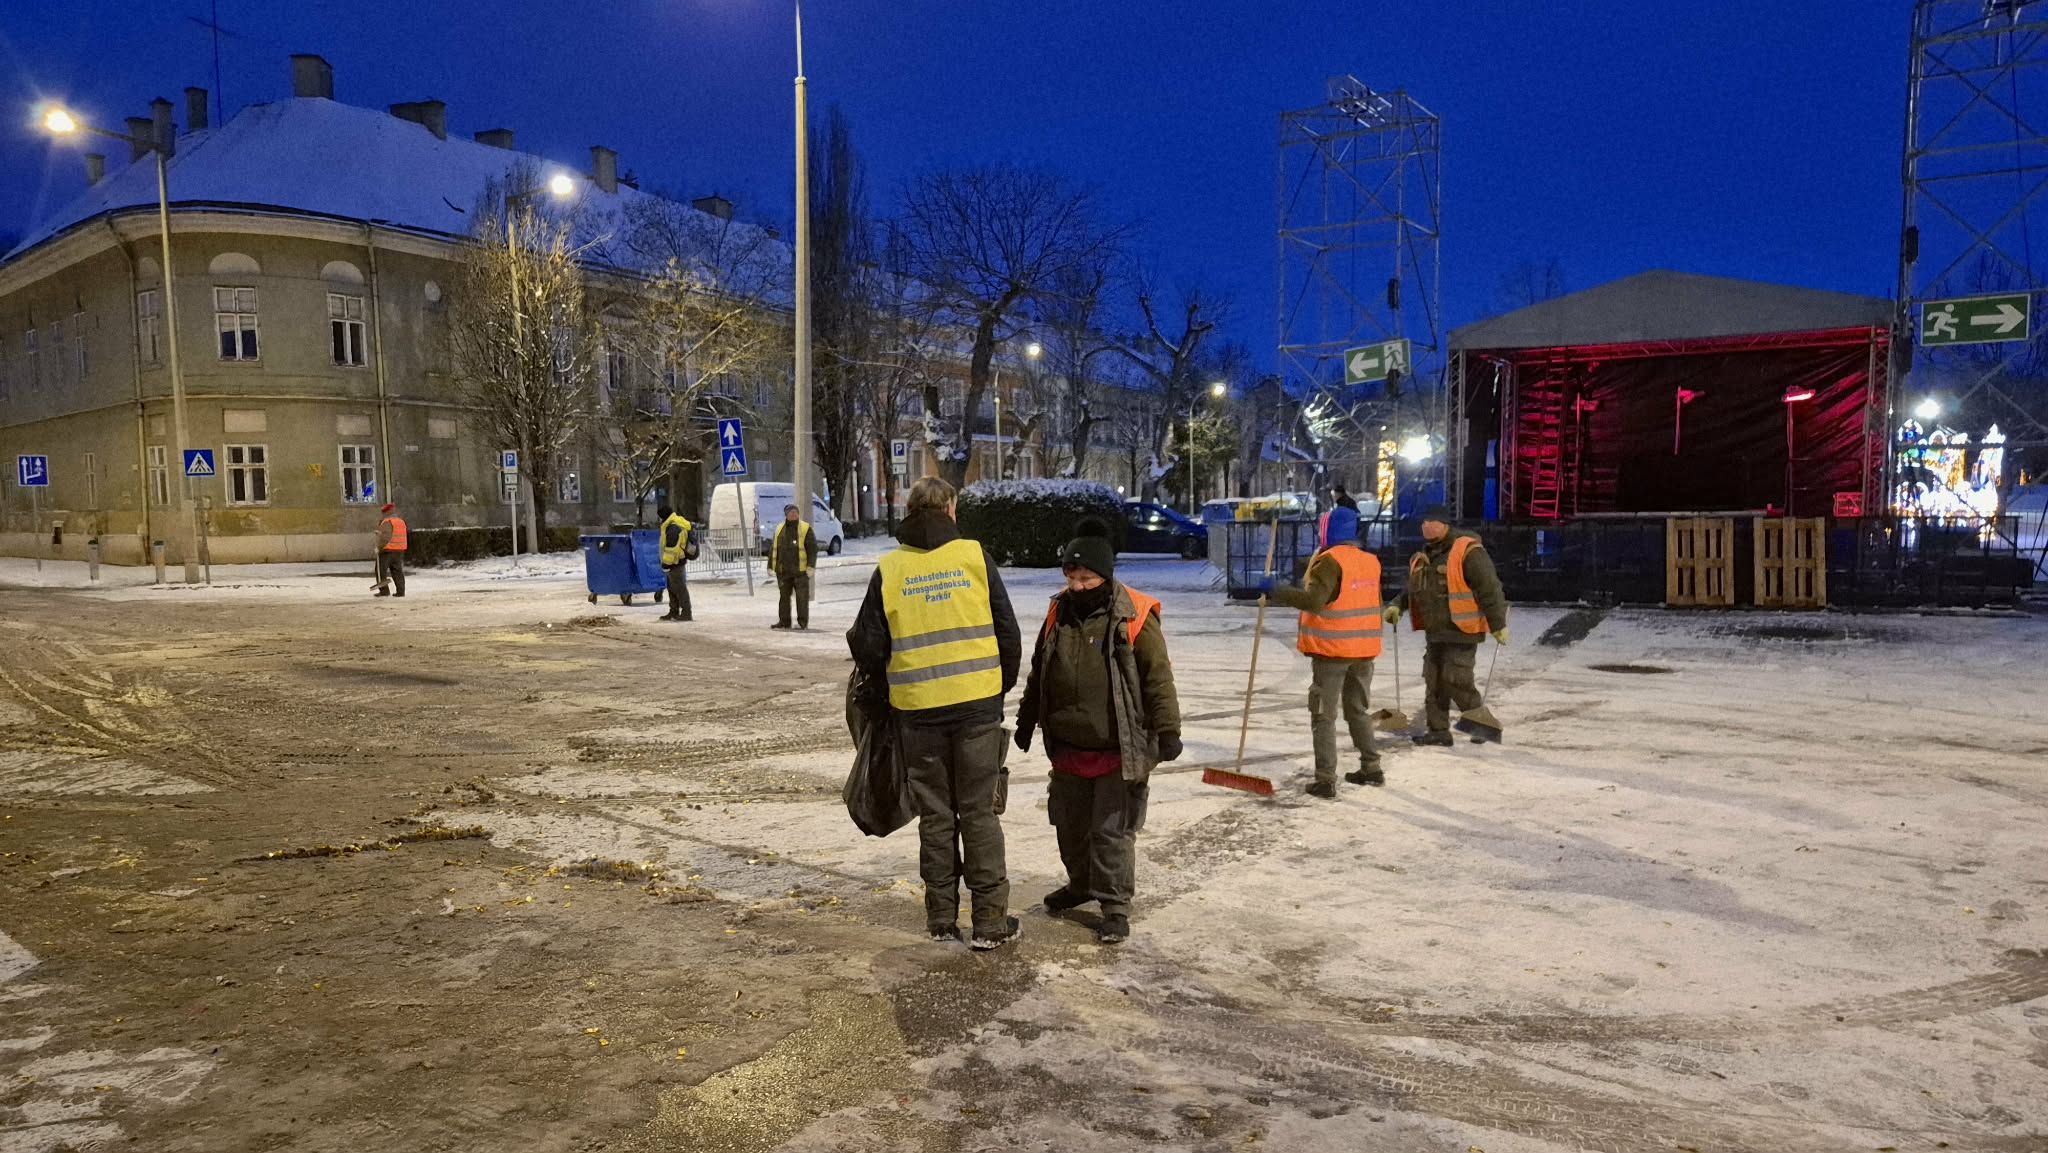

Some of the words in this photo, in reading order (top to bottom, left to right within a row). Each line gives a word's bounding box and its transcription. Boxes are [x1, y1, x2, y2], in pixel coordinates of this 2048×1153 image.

[895, 444, 903, 455] P
[506, 454, 514, 465] P
[904, 568, 964, 585] Székesfehérvár
[902, 578, 971, 596] Városgondnokság
